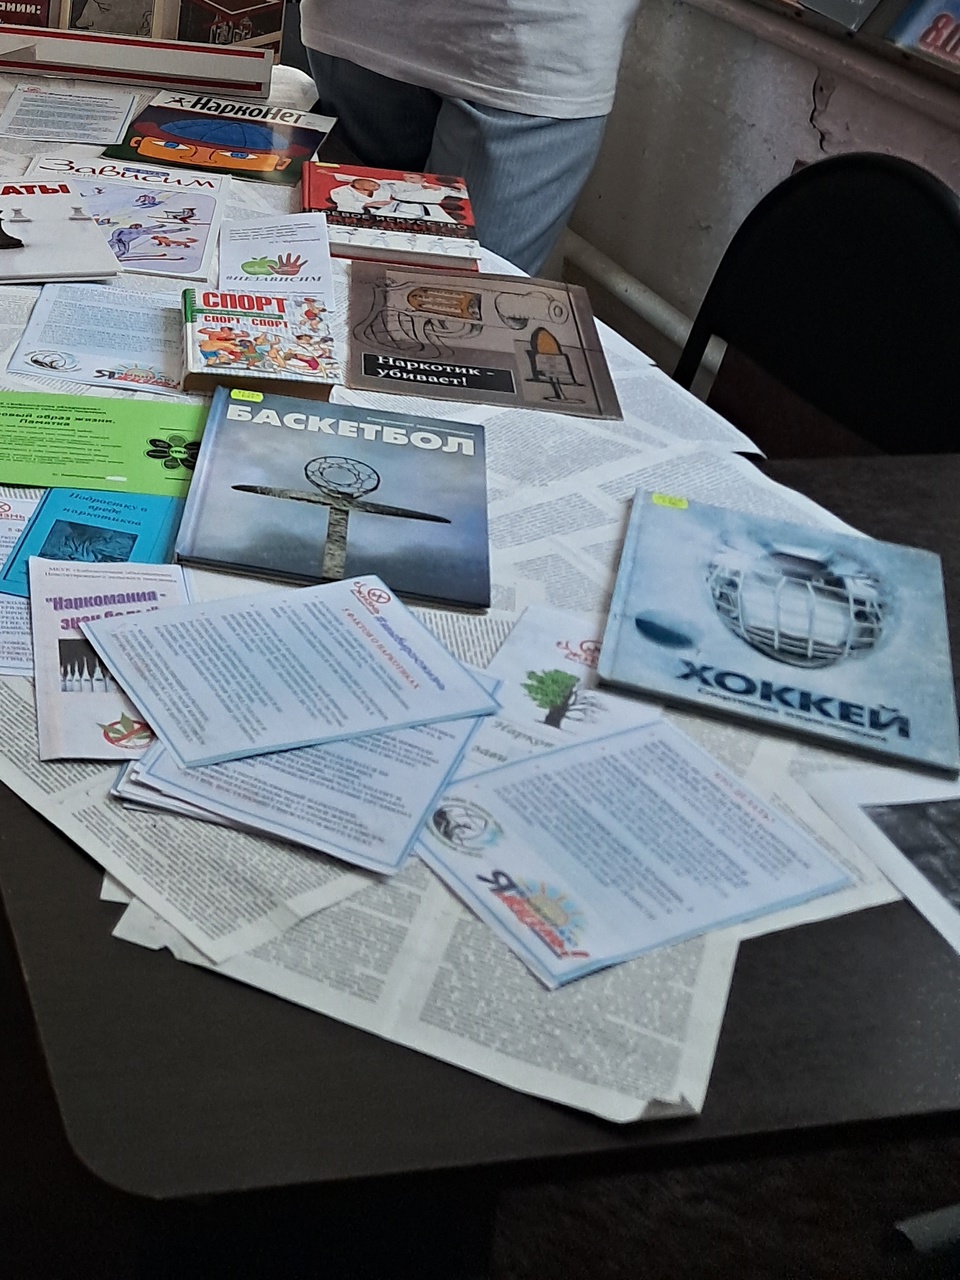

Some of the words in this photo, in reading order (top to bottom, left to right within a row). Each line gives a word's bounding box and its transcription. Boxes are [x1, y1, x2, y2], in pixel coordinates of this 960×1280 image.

[189, 95, 307, 126] НаркоНет
[39, 158, 216, 190] Зависим
[375, 215, 469, 231] ИСКУССТВО
[202, 291, 287, 314] СПОРТ
[251, 317, 289, 329] СПОРТ
[377, 354, 481, 377] Наркотик
[376, 366, 468, 388] убивает!
[18, 418, 71, 428] Памятка
[35, 413, 72, 422] образ
[225, 403, 476, 457] БАСКЕТБОЛ
[45, 590, 159, 612] "Наркомания
[675, 657, 912, 740] ХОККЕЙ
